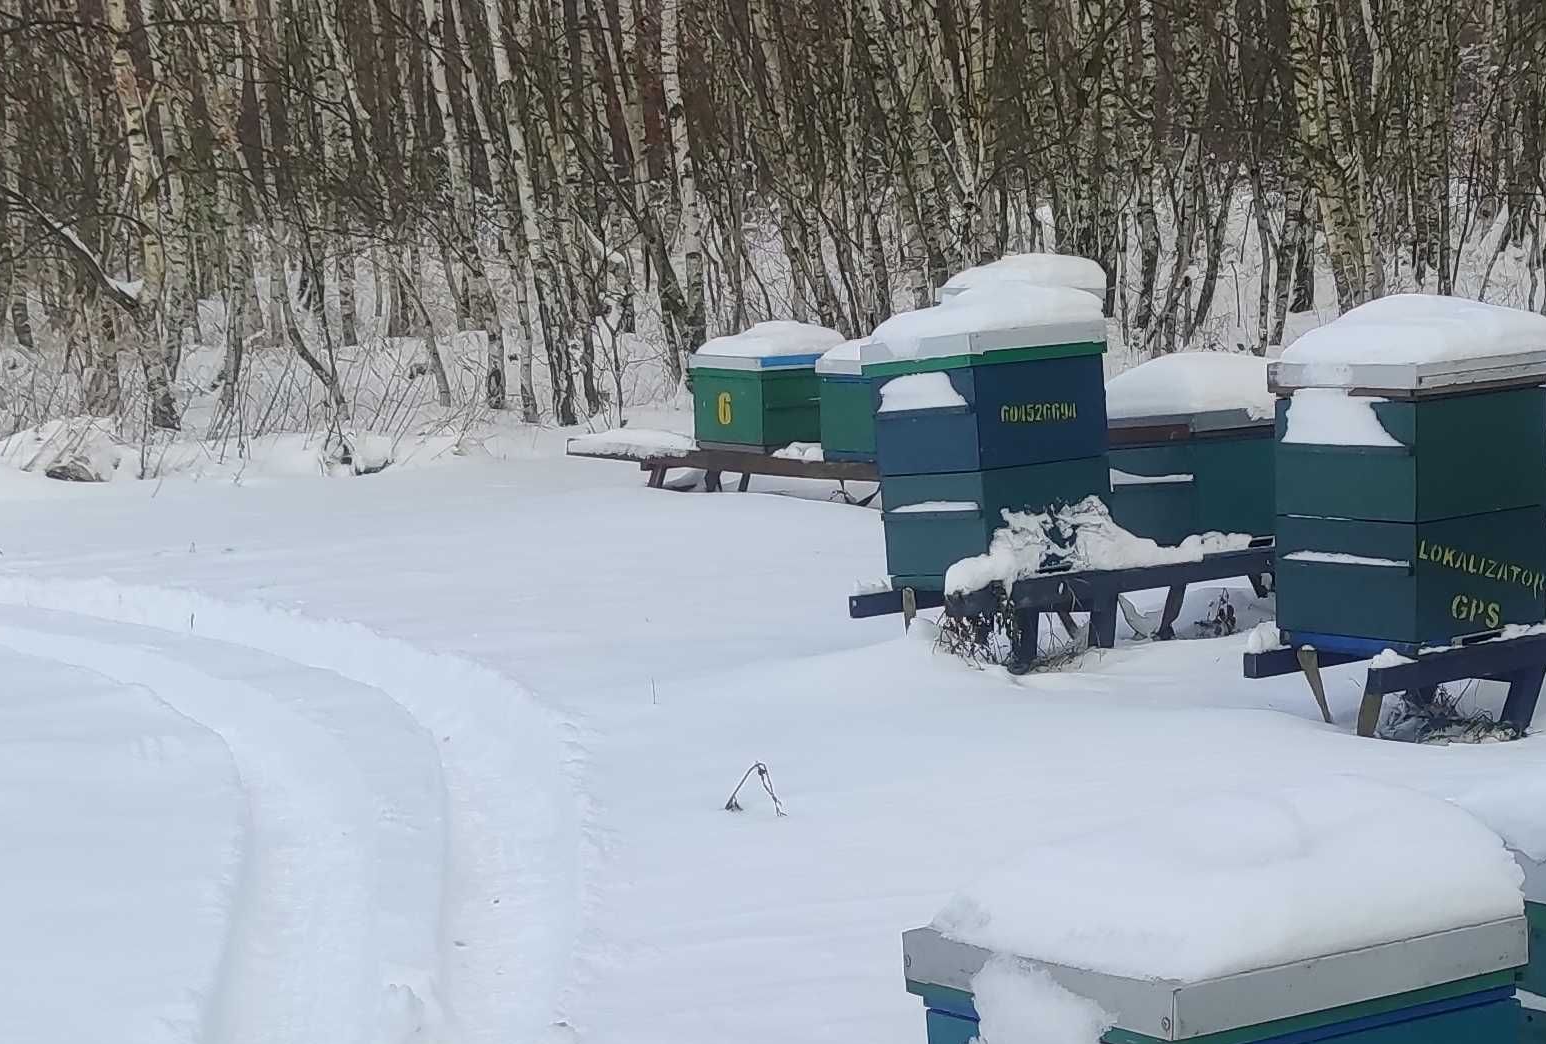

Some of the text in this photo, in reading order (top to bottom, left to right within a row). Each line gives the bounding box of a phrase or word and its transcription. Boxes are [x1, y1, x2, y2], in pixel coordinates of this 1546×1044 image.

[718, 392, 731, 424] 6
[1419, 540, 1545, 592] LOKALIZATOR
[1452, 594, 1500, 628] GPS
